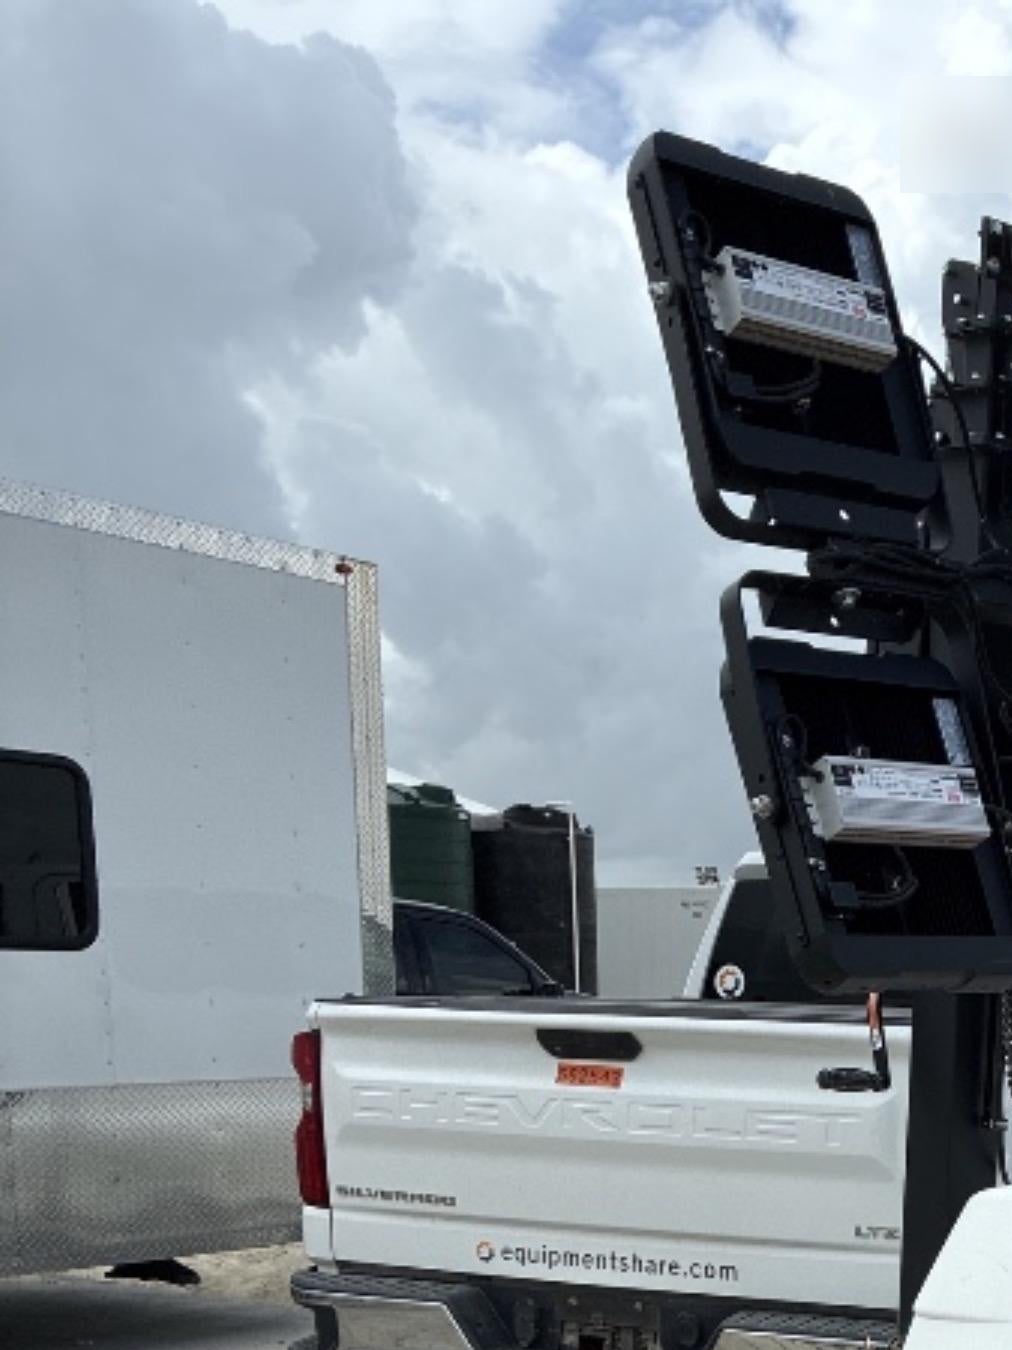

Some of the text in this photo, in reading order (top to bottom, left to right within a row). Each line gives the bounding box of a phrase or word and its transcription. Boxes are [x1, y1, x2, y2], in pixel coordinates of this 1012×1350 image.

[352, 1085, 863, 1147] CHEVROLET
[336, 1184, 456, 1207] SILVERADO
[501, 1244, 739, 1281] equipmentshare.com
